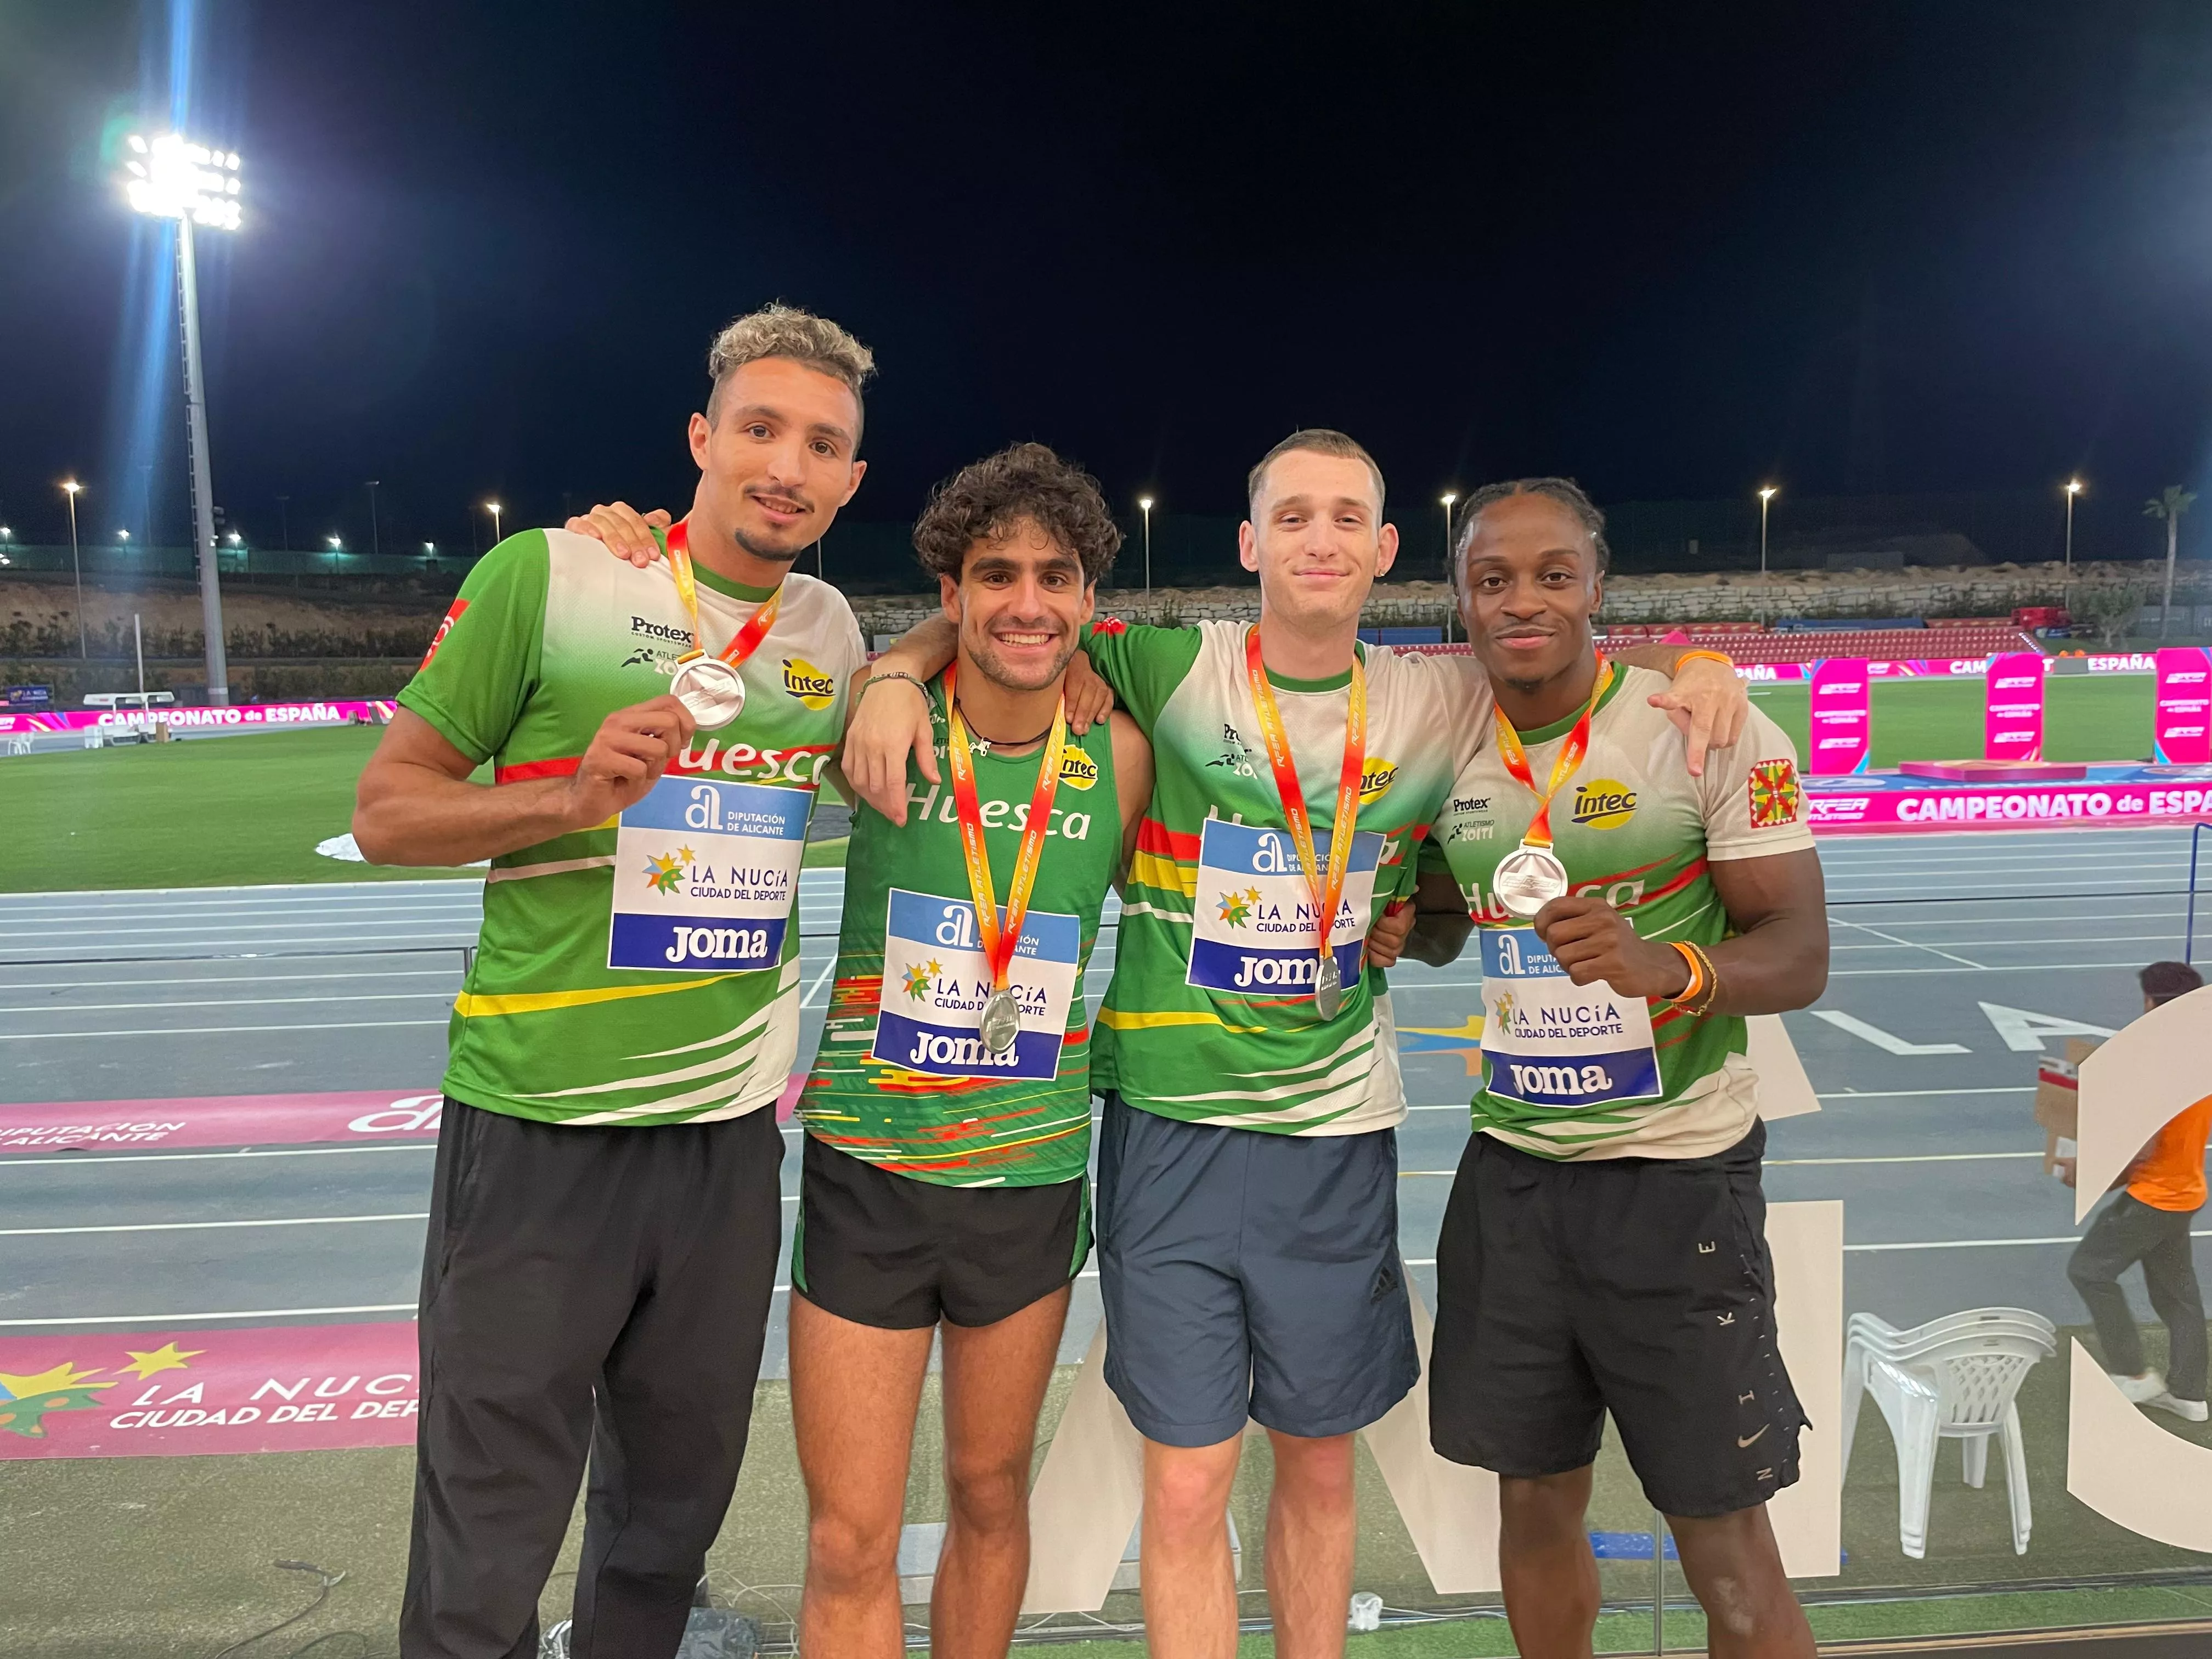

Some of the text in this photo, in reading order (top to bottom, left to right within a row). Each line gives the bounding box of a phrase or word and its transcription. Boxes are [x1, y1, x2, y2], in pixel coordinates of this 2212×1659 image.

[631, 616, 692, 643] Protex
[782, 659, 834, 695] intec
[245, 710, 262, 721] de
[266, 703, 340, 722] ESPAÑA
[1453, 797, 1489, 812] Protex
[1574, 786, 1638, 815] intec
[1897, 793, 2112, 822] CAMPEONATO
[2117, 794, 2142, 813] de
[728, 811, 786, 825] DIPUTACIÓN
[727, 822, 785, 836] DE ALICANTE
[692, 865, 715, 884] LA
[690, 887, 786, 901] CIUDAD DEL DEPORTE
[1259, 904, 1281, 920] LA
[1256, 923, 1296, 933] CIUDAD
[1300, 922, 1316, 932] DEL
[1528, 966, 1540, 974] DE
[938, 979, 960, 996] LA
[935, 998, 974, 1011] CIUDAD
[1513, 1008, 1529, 1025] LA
[1515, 1023, 1623, 1039] CIUDAD DEL DEPORTE
[0, 1121, 186, 1137] IPUTACIÓN
[132, 1382, 205, 1406] LA
[110, 1407, 262, 1429] CIUDAD
[267, 1403, 339, 1424] DEL
